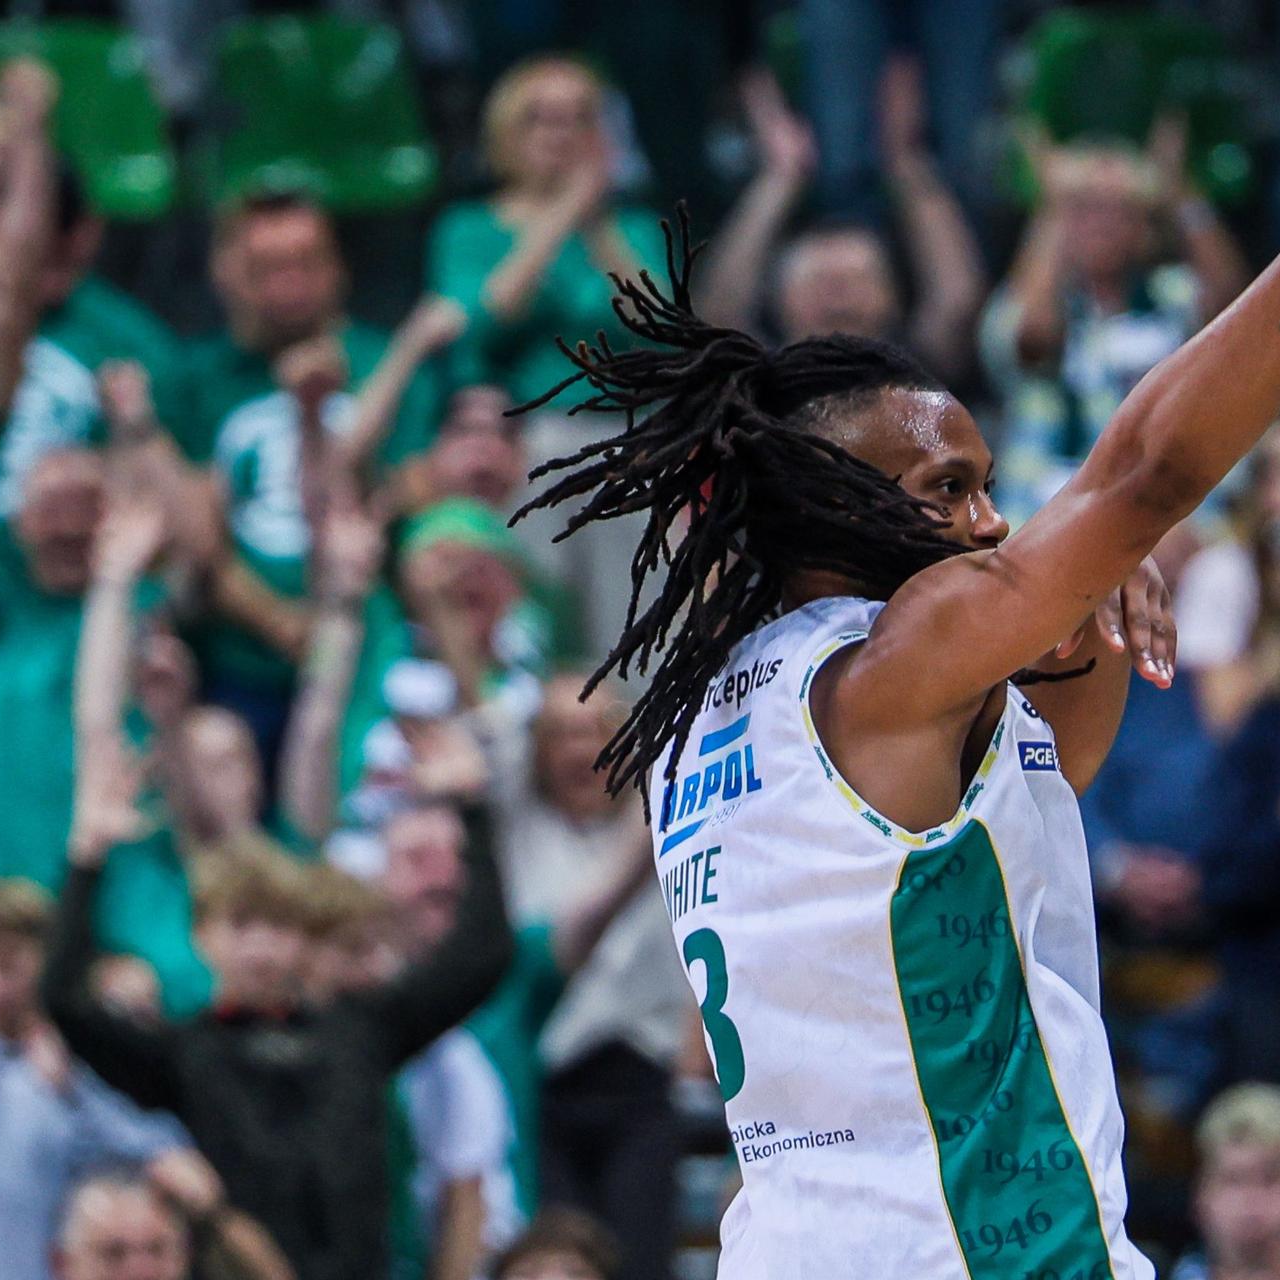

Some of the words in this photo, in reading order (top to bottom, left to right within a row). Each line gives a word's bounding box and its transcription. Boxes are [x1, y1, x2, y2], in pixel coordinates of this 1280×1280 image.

[705, 658, 784, 713] rceptus
[1024, 747, 1054, 767] PGE
[935, 905, 1008, 949] 1946
[909, 964, 995, 1025] 1946
[742, 1129, 855, 1163] Ekonomiczna
[981, 1139, 1075, 1185] 1946
[962, 1199, 1053, 1257] 1946
